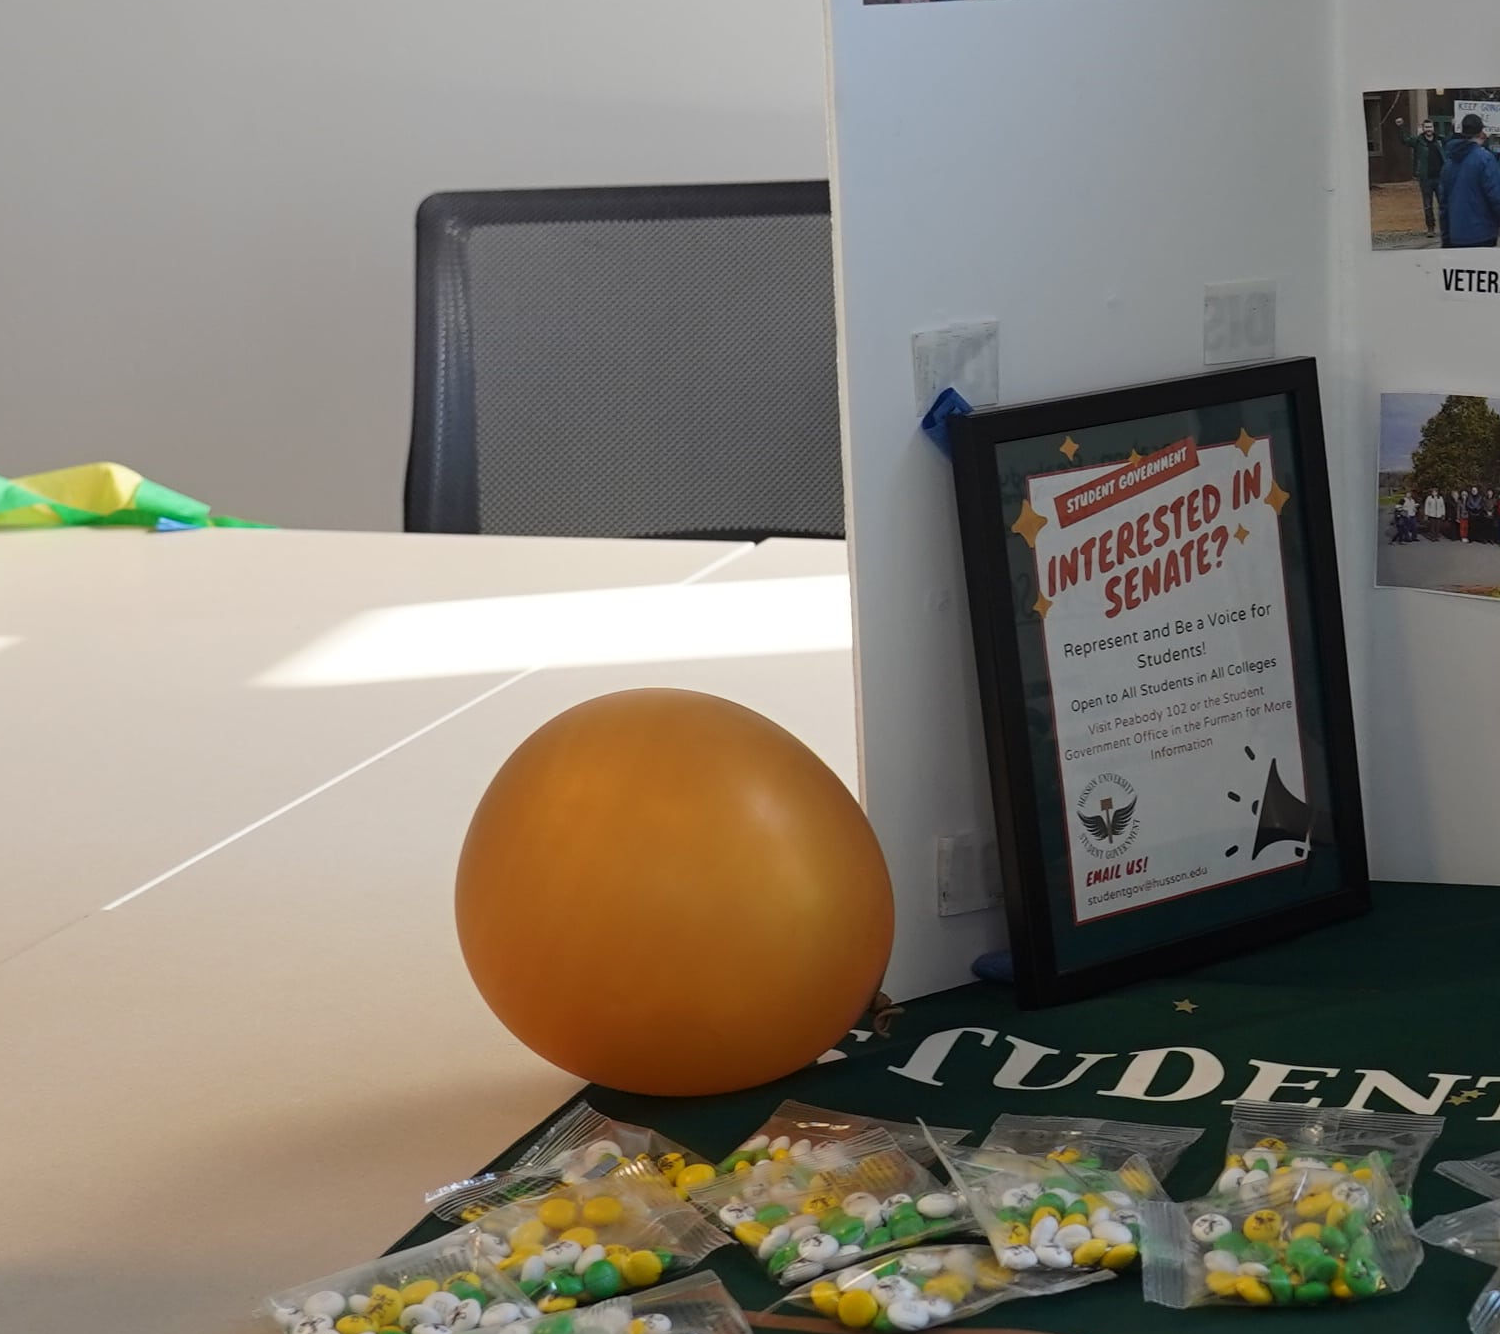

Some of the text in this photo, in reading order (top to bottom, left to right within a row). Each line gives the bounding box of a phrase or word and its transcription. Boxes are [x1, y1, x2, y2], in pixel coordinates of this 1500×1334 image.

[1066, 447, 1188, 513] STUDENT GOVERNMENT
[1049, 462, 1261, 597] INTERESTED IN
[1105, 526, 1228, 618] SENATE?
[1064, 603, 1271, 659] Represent and Be a Voice for
[1137, 642, 1207, 669] Students!
[1071, 657, 1277, 713] Open to All Students in All Colleges
[1088, 721, 1112, 735] Visit
[1115, 709, 1163, 731] Peabody
[1190, 702, 1201, 712] or
[1204, 695, 1220, 709] the
[1223, 686, 1265, 705] Student
[1065, 735, 1131, 761] Government
[1133, 727, 1168, 744] Office
[1171, 725, 1182, 736] in
[1185, 721, 1201, 733] the
[1246, 704, 1261, 719] for
[1264, 699, 1292, 714] More
[1151, 736, 1213, 760] Information
[1086, 856, 1148, 887] EMAIL US!
